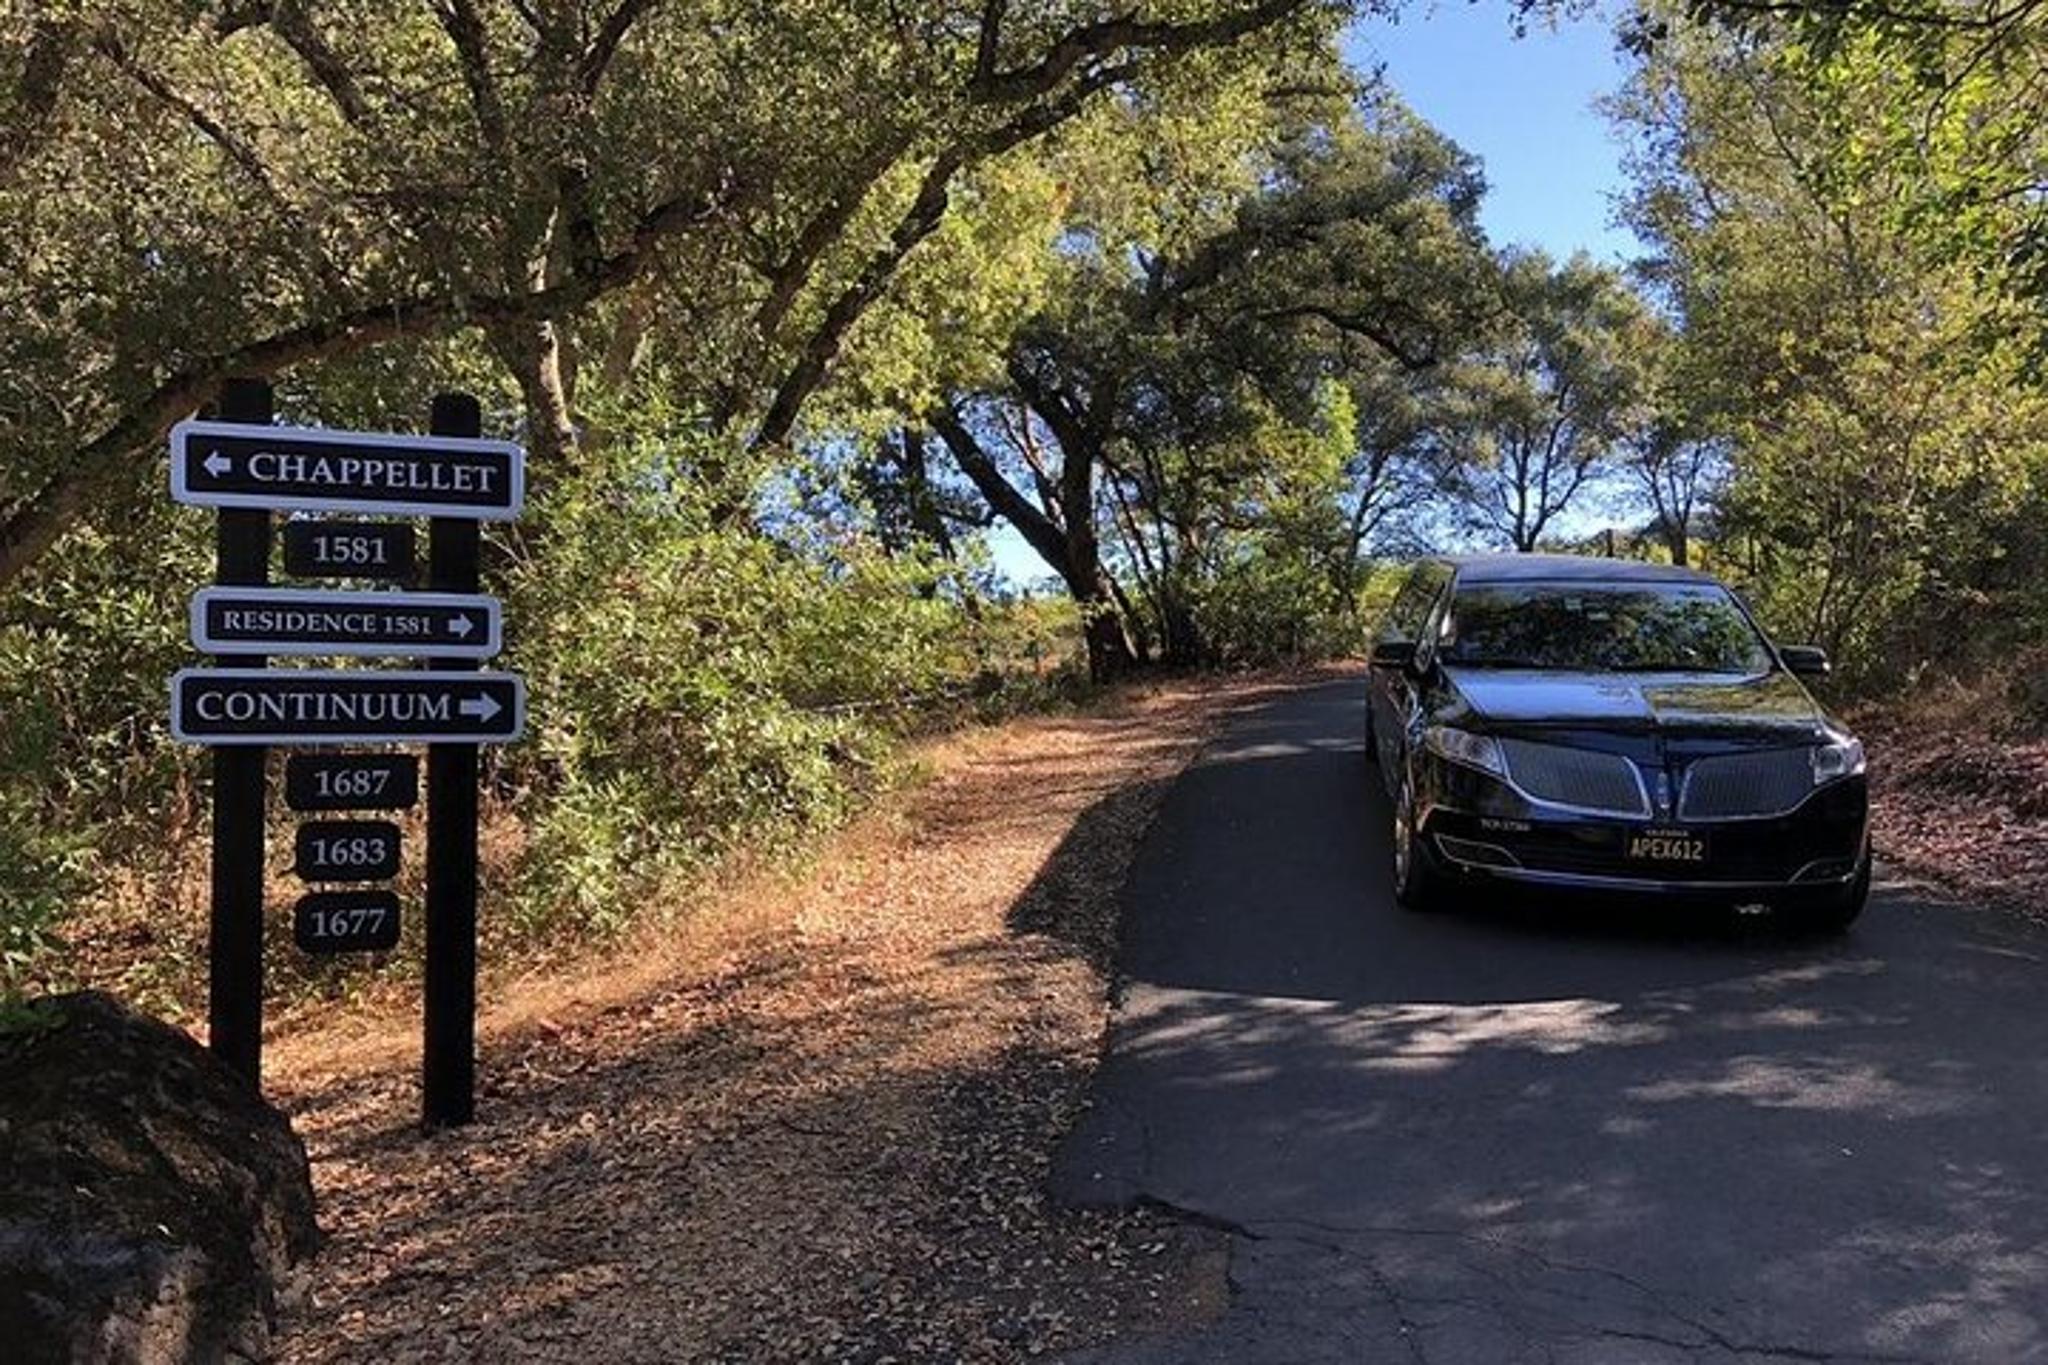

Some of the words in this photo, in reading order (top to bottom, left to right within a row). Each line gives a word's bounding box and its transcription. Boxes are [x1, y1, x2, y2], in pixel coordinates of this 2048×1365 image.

[248, 452, 498, 493] CHAPPELLET
[314, 536, 387, 563] 1581
[223, 609, 376, 634] RESIDENCE
[384, 616, 432, 634] 1581
[195, 692, 449, 721] CONTINUUM
[315, 769, 390, 796] 1687
[312, 839, 386, 866] 1683
[1630, 838, 1703, 859] APEX612
[311, 909, 385, 937] 1677
